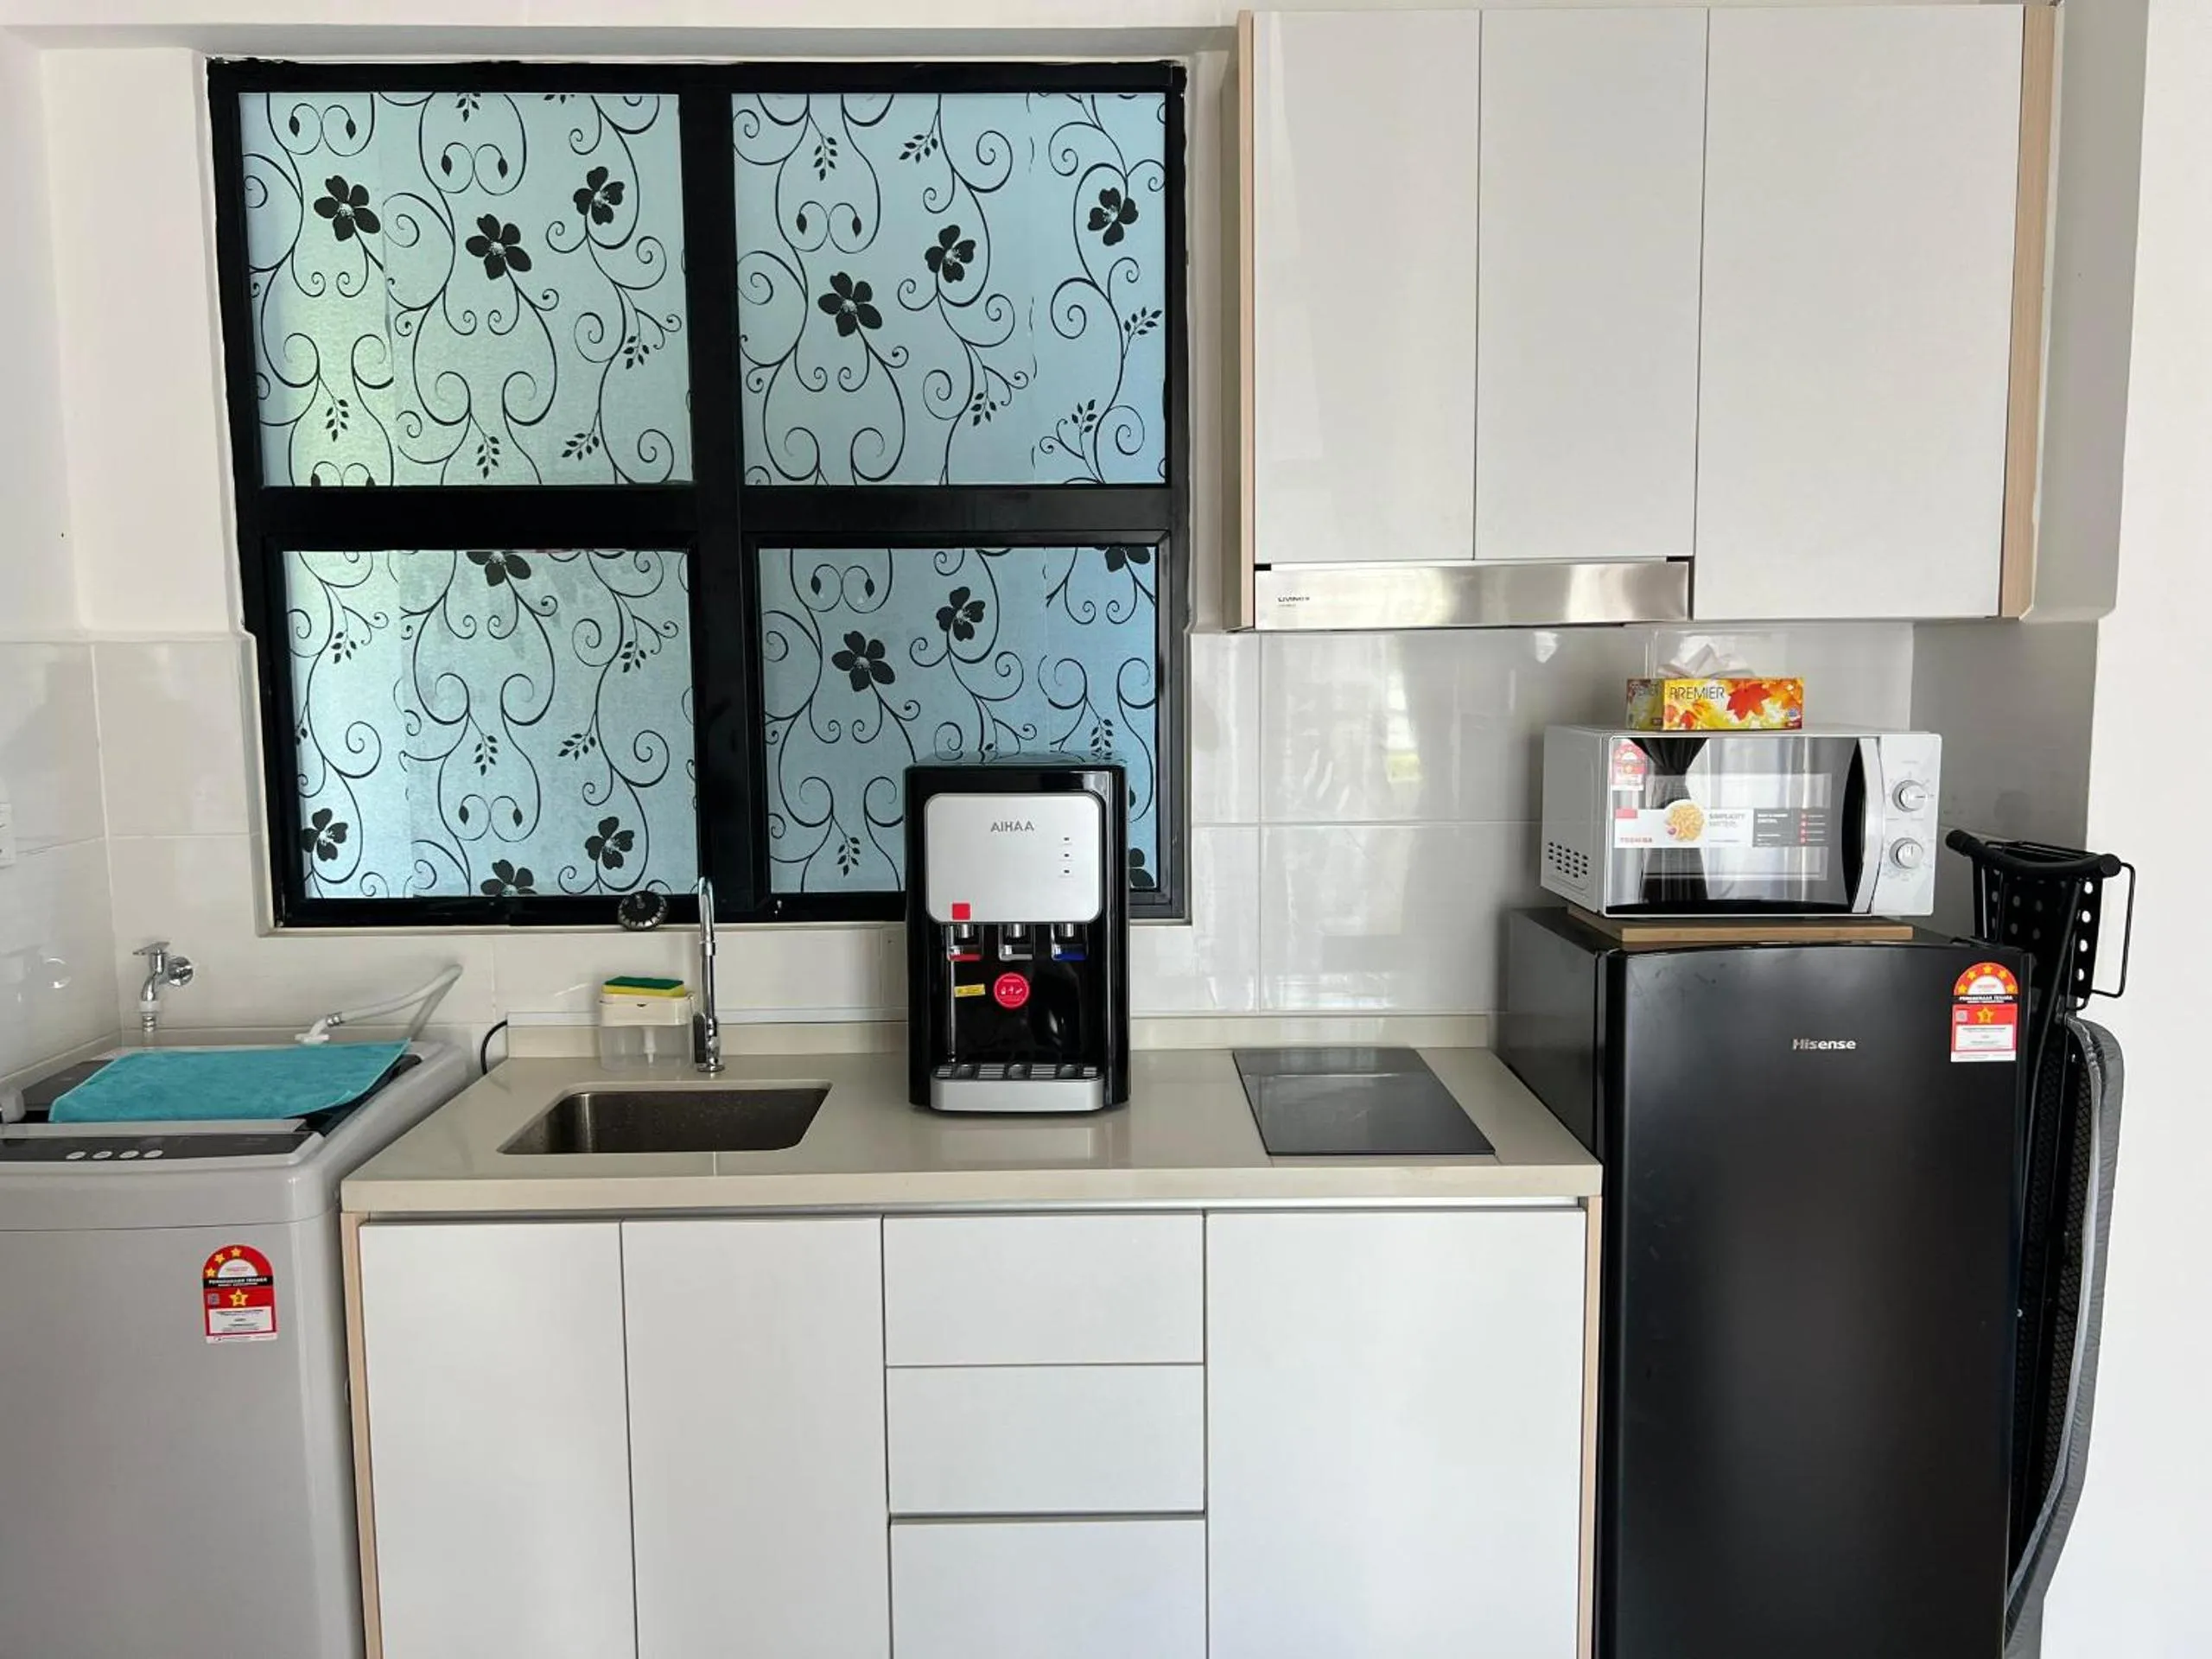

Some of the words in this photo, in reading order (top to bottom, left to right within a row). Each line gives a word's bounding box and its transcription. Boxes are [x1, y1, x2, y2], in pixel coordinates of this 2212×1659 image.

[1669, 687, 1725, 699] PREMIER
[990, 820, 1035, 832] AIHAA
[1792, 1038, 1857, 1051] Hisense
